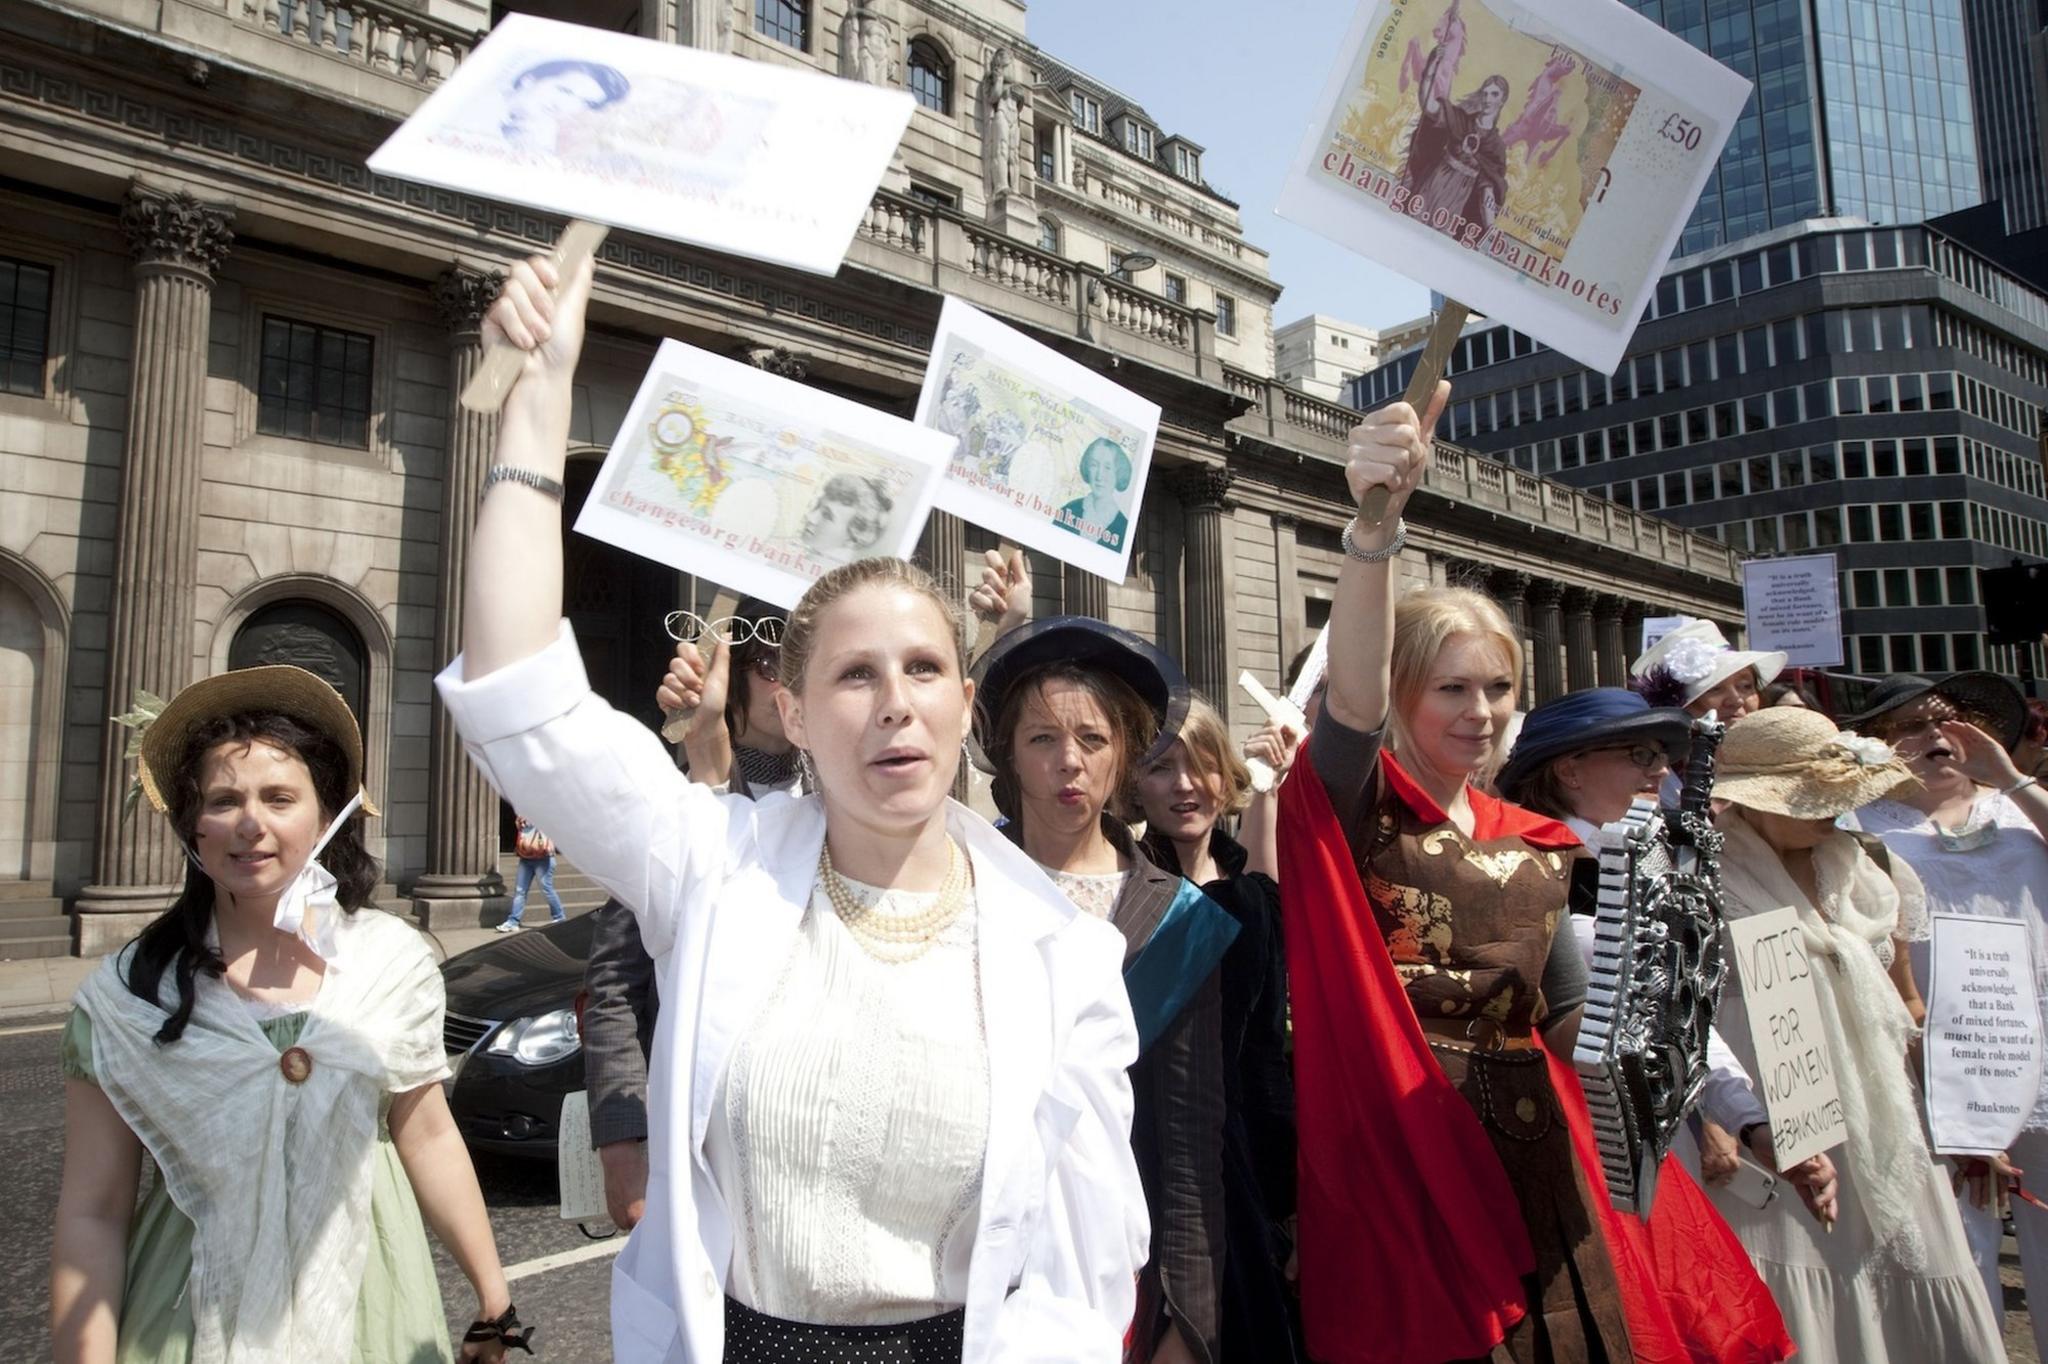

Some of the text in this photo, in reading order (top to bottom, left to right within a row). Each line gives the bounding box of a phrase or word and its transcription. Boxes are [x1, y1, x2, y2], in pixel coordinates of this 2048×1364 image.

[1581, 62, 1625, 97] Pounds
[1656, 112, 1702, 151] £50
[1322, 150, 1623, 316] change.org/banknotes
[1528, 219, 1571, 249] England
[608, 489, 822, 578] change.org/bankn
[1738, 926, 1810, 1000] NOTES
[1978, 948, 1985, 960] is
[1987, 952, 1992, 961] a
[1993, 950, 2010, 962] truth
[1969, 966, 2009, 981] universally
[1961, 982, 2018, 996] acknowledged,
[1969, 999, 2015, 1011] that a Bank
[1769, 1006, 1804, 1052] FOR
[1952, 1014, 1964, 1025] of
[1965, 1015, 1994, 1027] mixed
[1944, 1031, 2034, 1045] must be in want of a
[1951, 1047, 2031, 1062] female role model
[1763, 1044, 1829, 1105] WOMEN
[1964, 1066, 1977, 1076] on
[1979, 1065, 1992, 1077] its
[1966, 1101, 2020, 1114] #banknotes
[1773, 1097, 1846, 1157] #BANKNOTES
